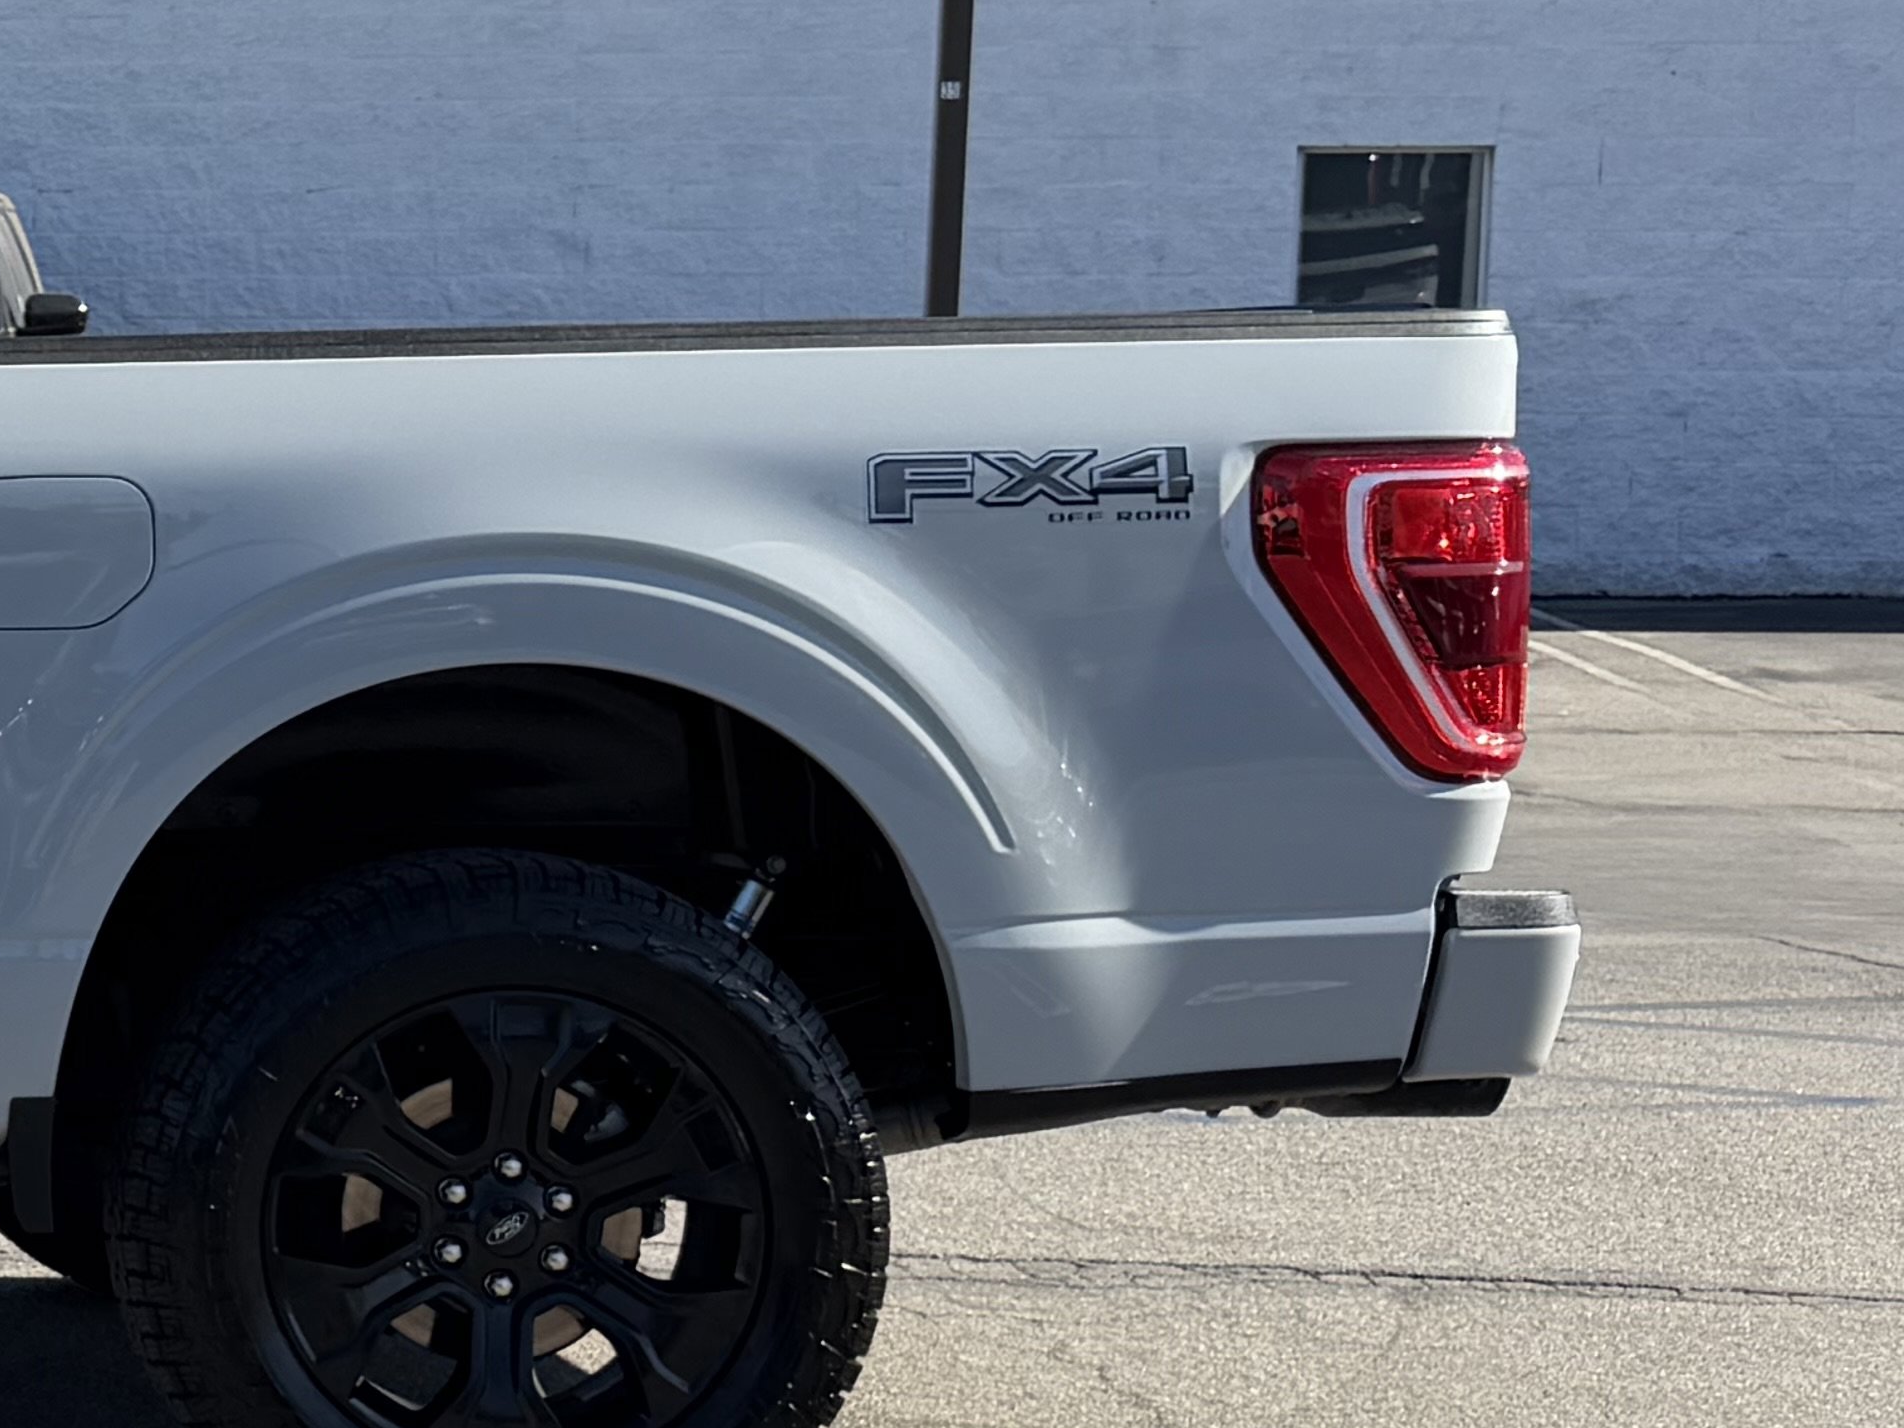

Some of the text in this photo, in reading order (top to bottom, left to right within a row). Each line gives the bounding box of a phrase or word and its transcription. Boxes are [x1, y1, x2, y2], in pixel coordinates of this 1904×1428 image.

[867, 447, 1193, 523] FX4
[1048, 509, 1191, 523] OFF ROAD
